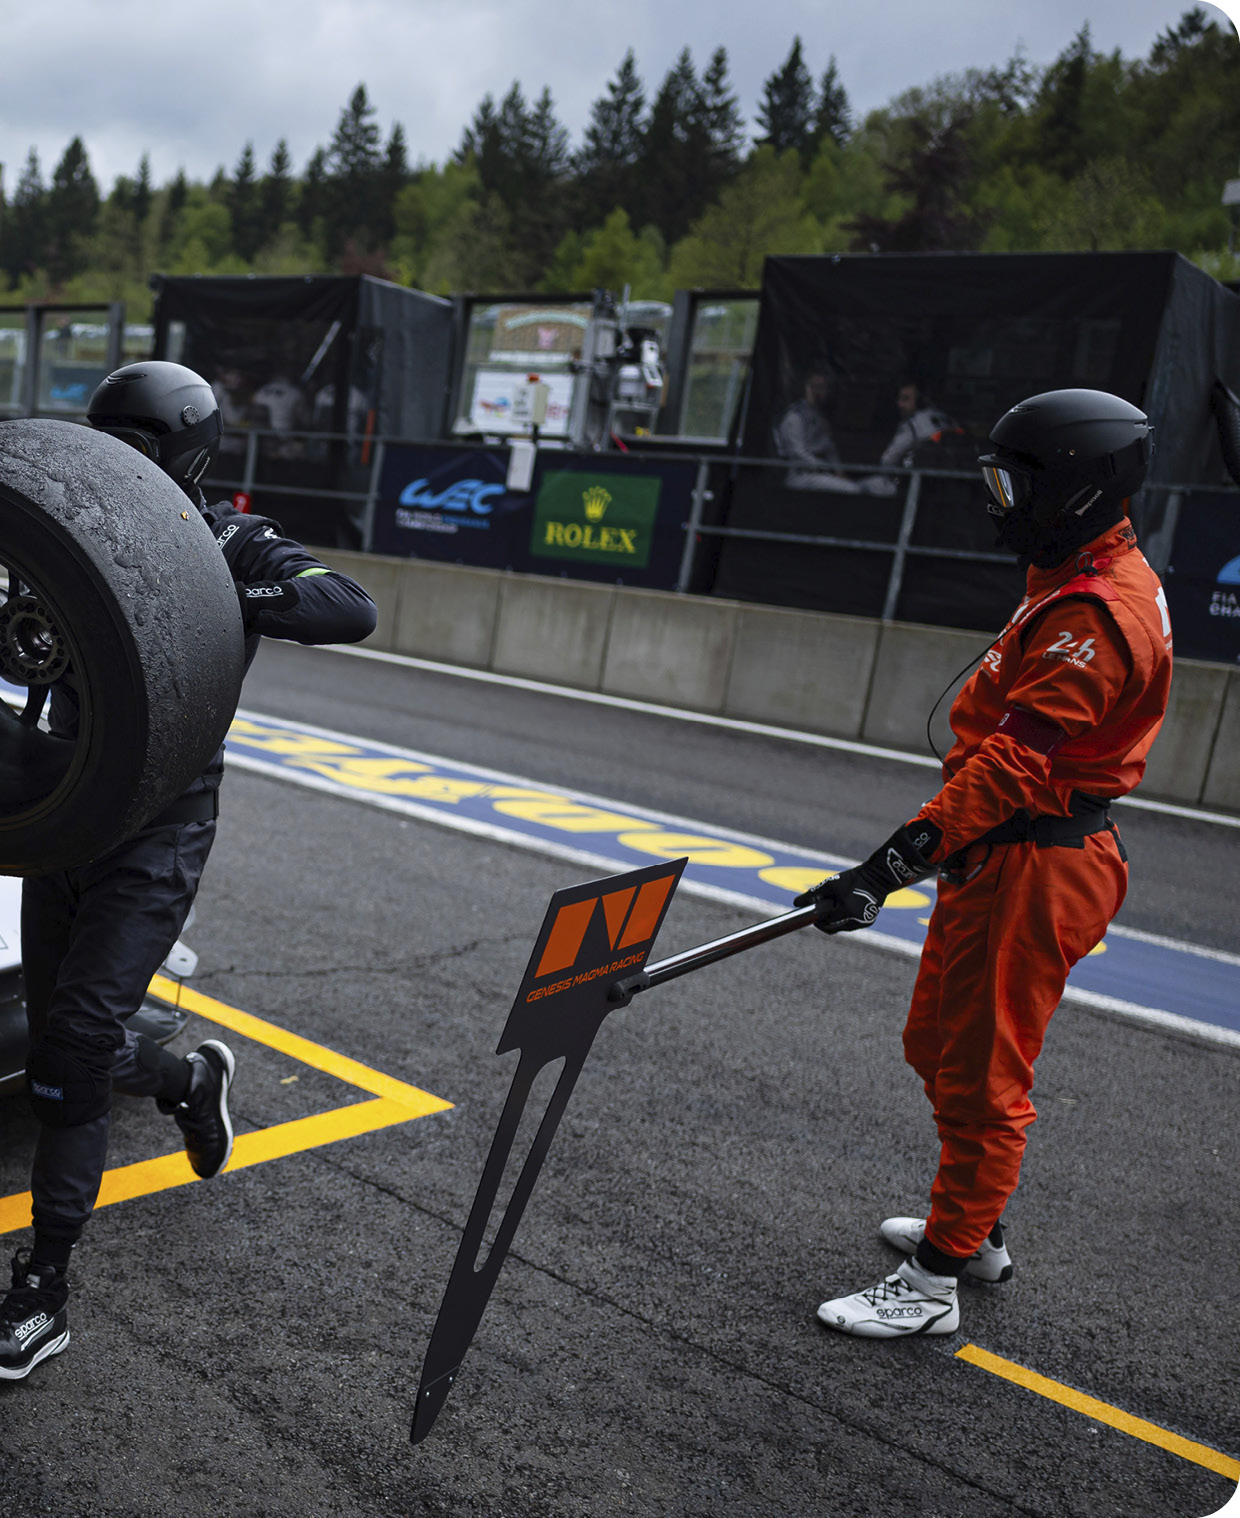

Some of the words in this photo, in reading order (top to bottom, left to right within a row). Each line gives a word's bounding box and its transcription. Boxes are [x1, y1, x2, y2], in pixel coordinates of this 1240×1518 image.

[399, 477, 508, 515] WEC
[544, 521, 637, 554] ROLEX
[1042, 651, 1057, 661] LE
[526, 977, 573, 1003] GENESIS
[572, 965, 609, 987] MAGMA
[609, 951, 646, 974] RACING
[14, 1312, 48, 1341] sparco
[876, 1306, 923, 1320] sparco
